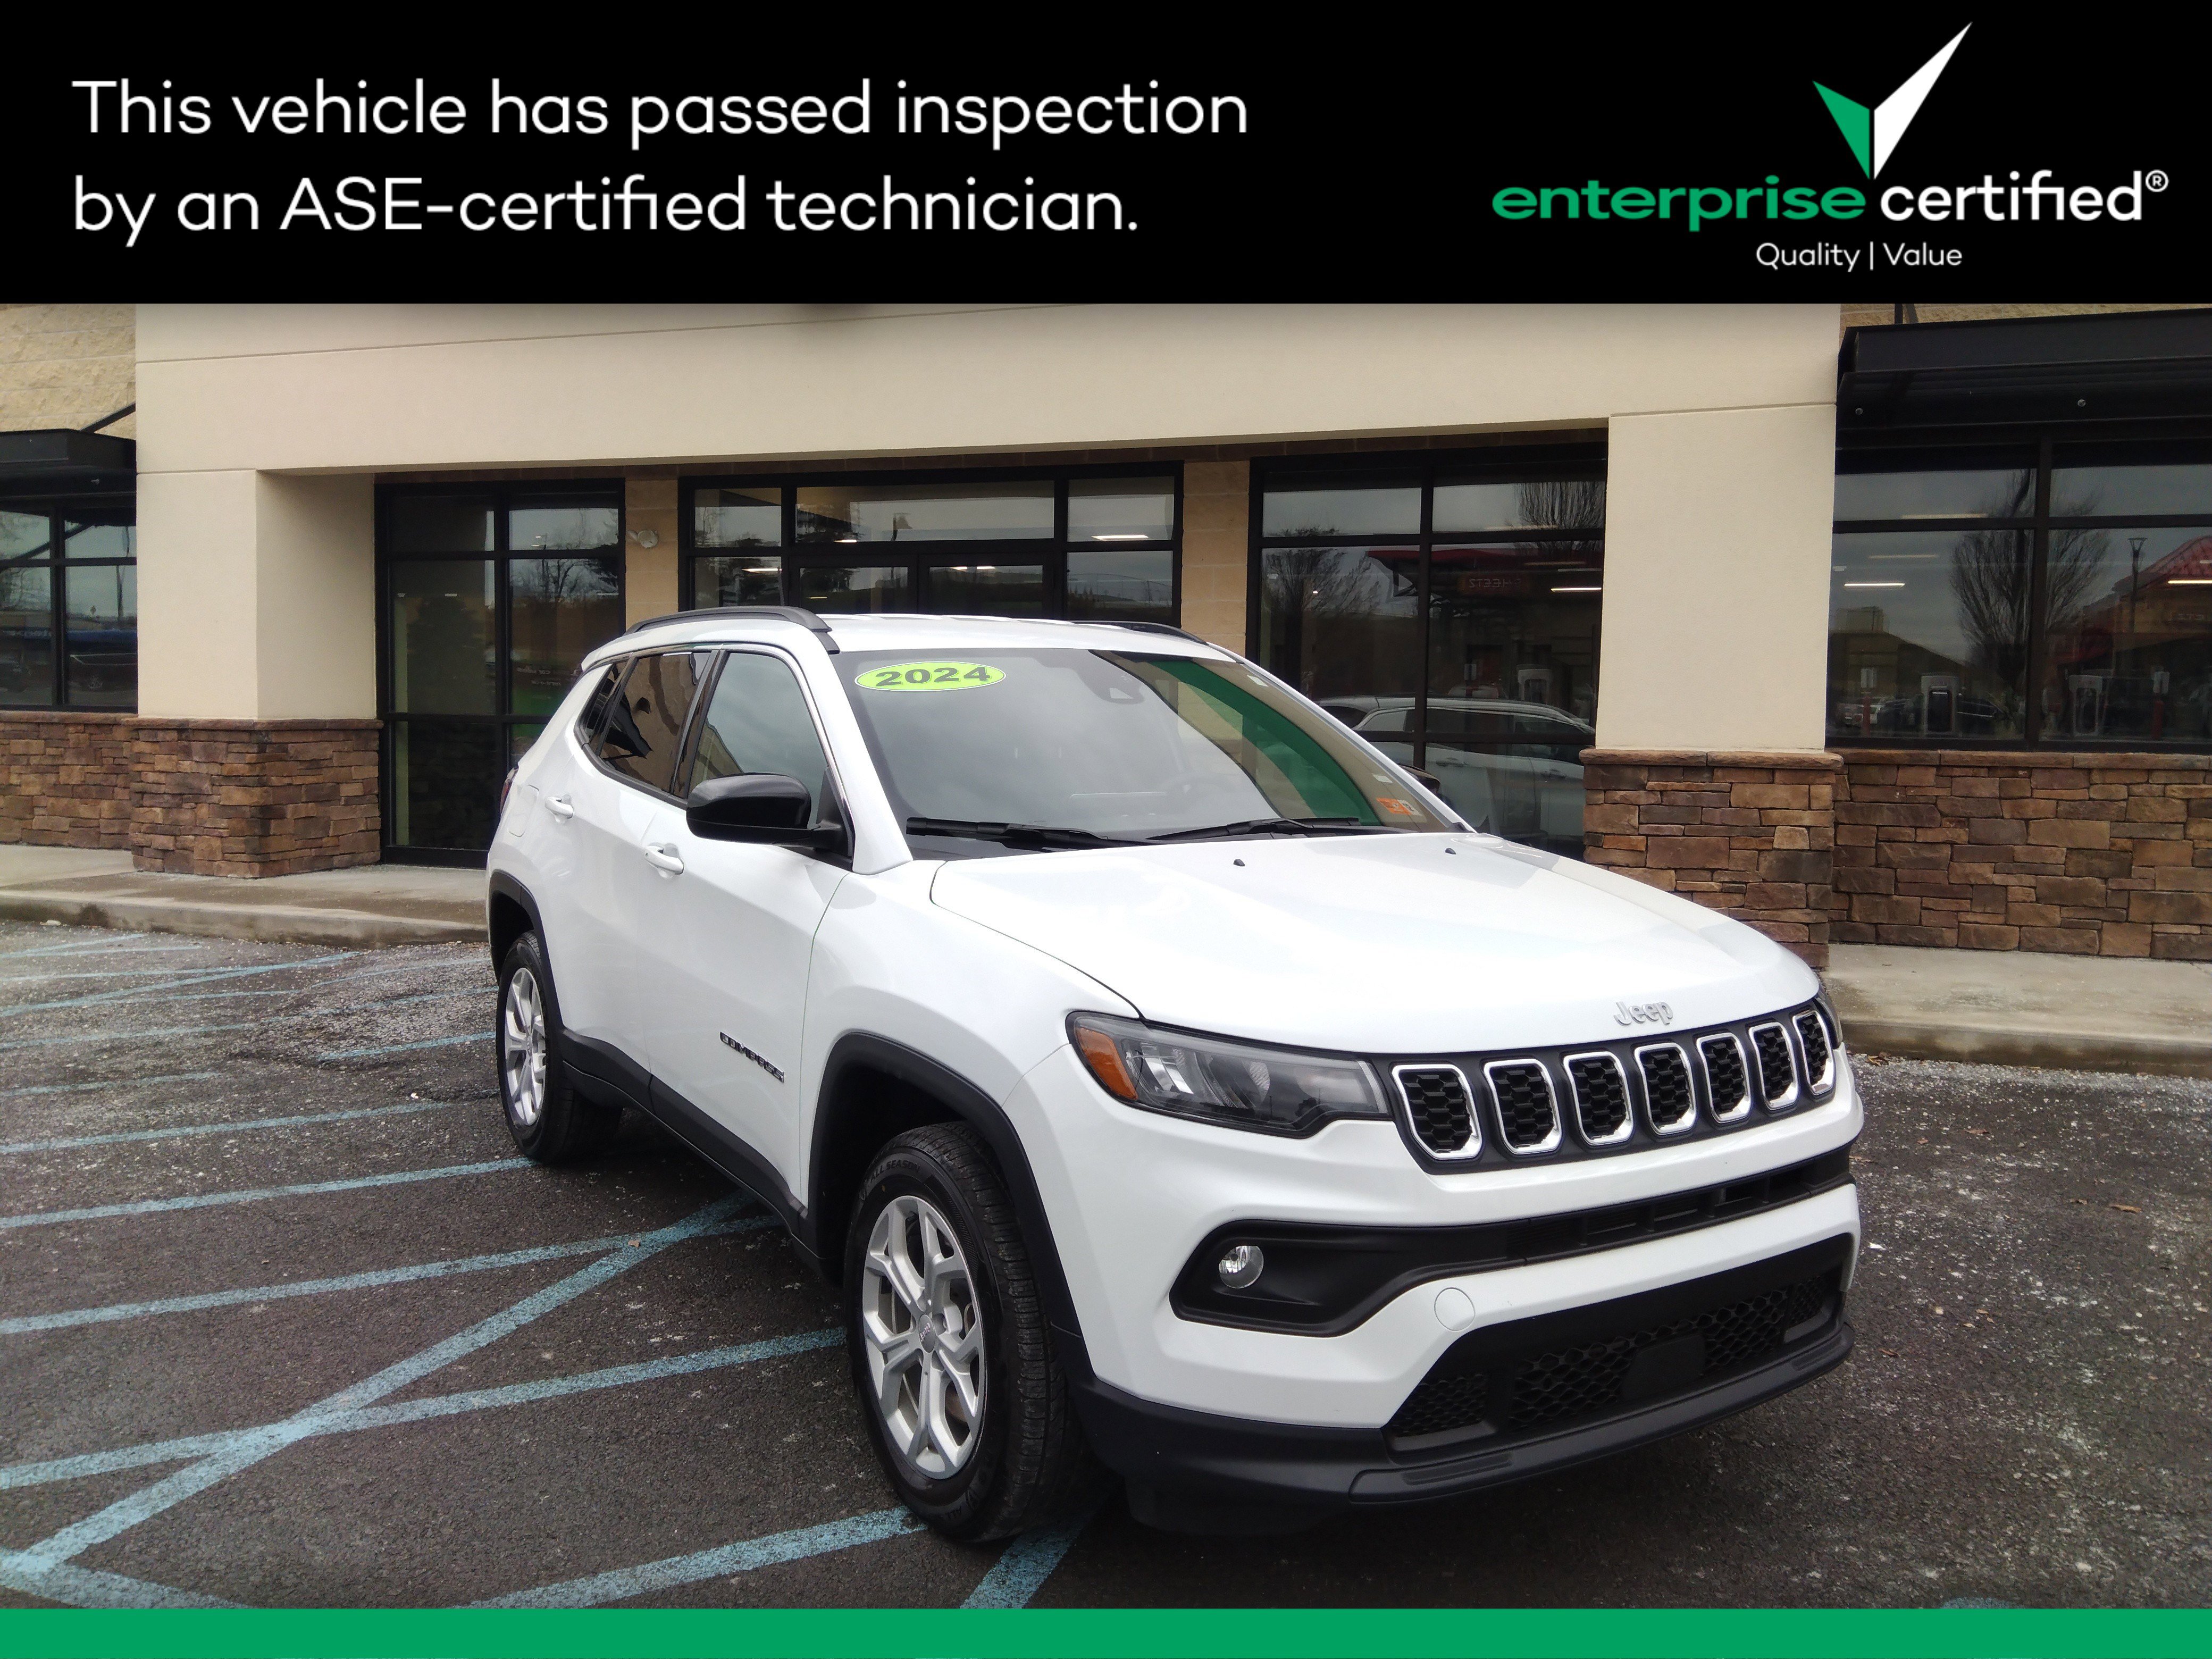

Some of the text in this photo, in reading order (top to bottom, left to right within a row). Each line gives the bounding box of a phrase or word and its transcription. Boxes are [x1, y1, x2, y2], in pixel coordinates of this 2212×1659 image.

[875, 667, 991, 686] 2024
[1613, 1001, 1673, 1027] Jeep
[719, 1031, 785, 1083] COMPASS
